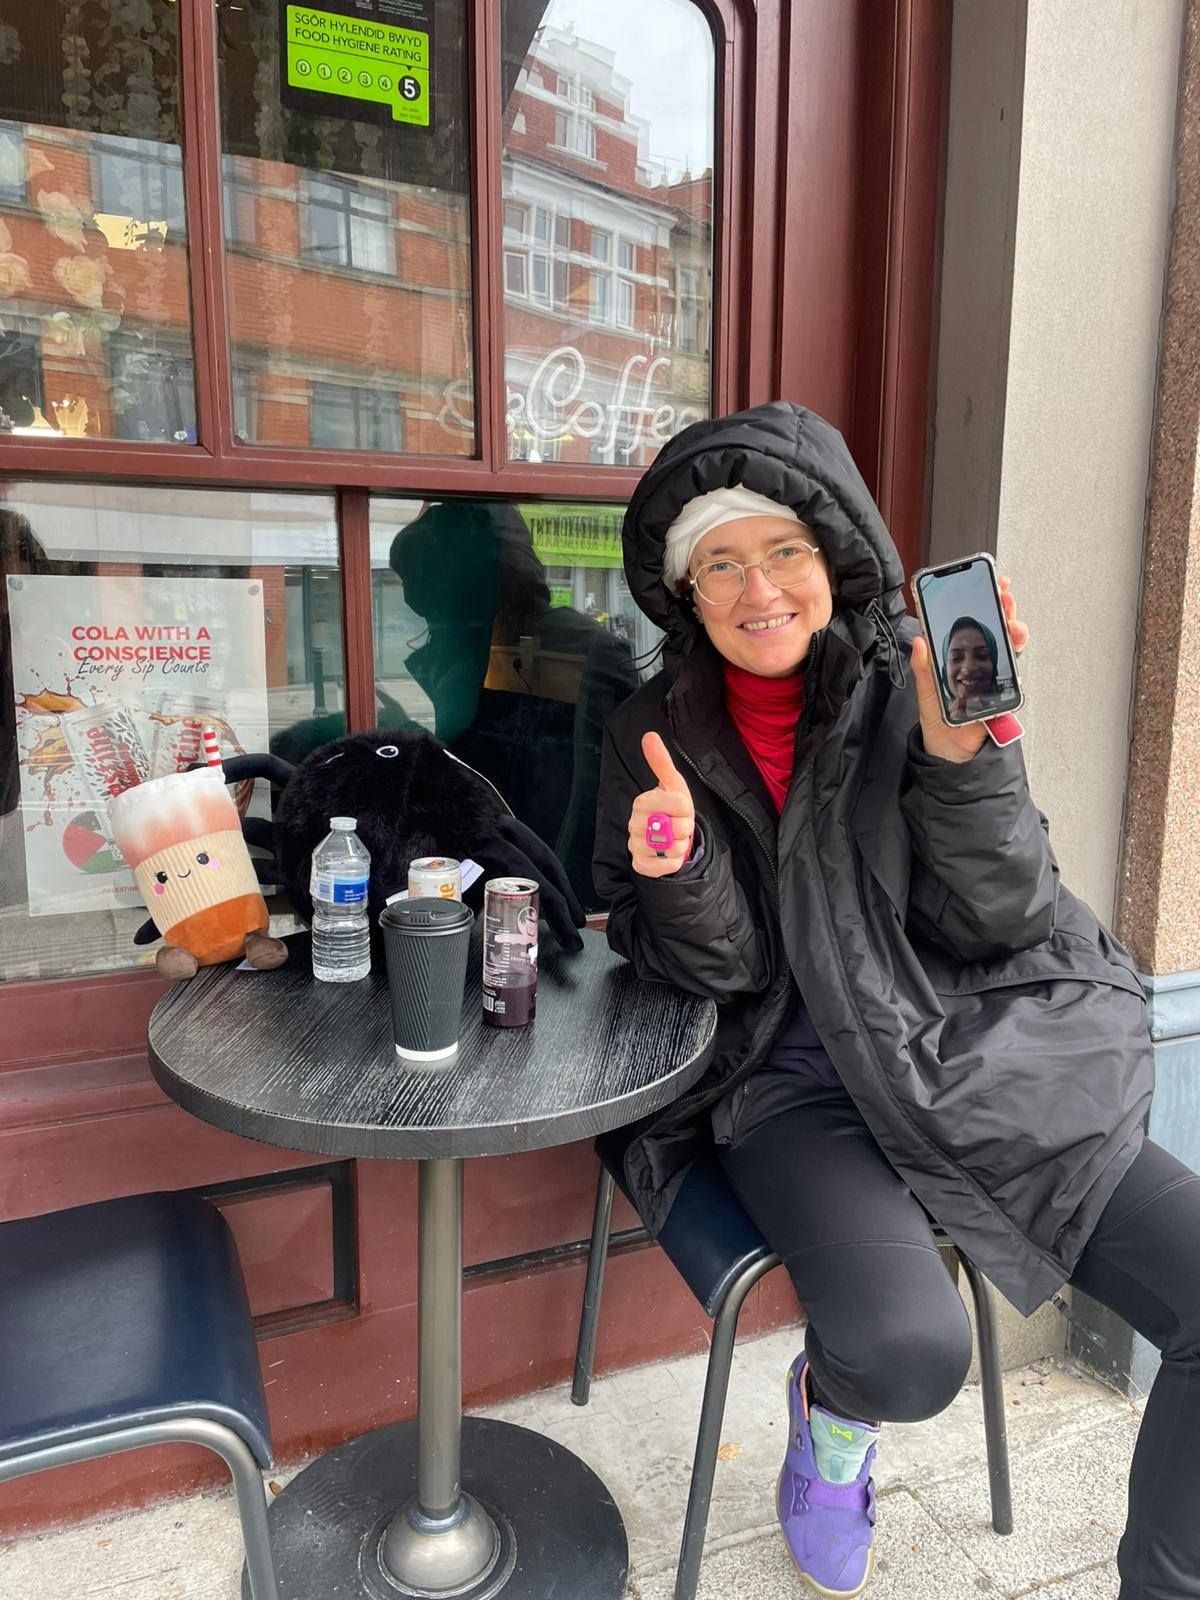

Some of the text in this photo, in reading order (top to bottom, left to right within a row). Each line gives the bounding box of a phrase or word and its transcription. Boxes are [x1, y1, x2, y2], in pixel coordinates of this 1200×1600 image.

[294, 12, 422, 48] SGÔR HYLENDID BWYD
[294, 28, 422, 62] FOOD HYGIENE RATING
[402, 78, 416, 98] 5
[71, 625, 212, 641] COLA WITH A
[73, 645, 212, 662] CONSCIENCE
[78, 656, 210, 682] Every Sip Counts
